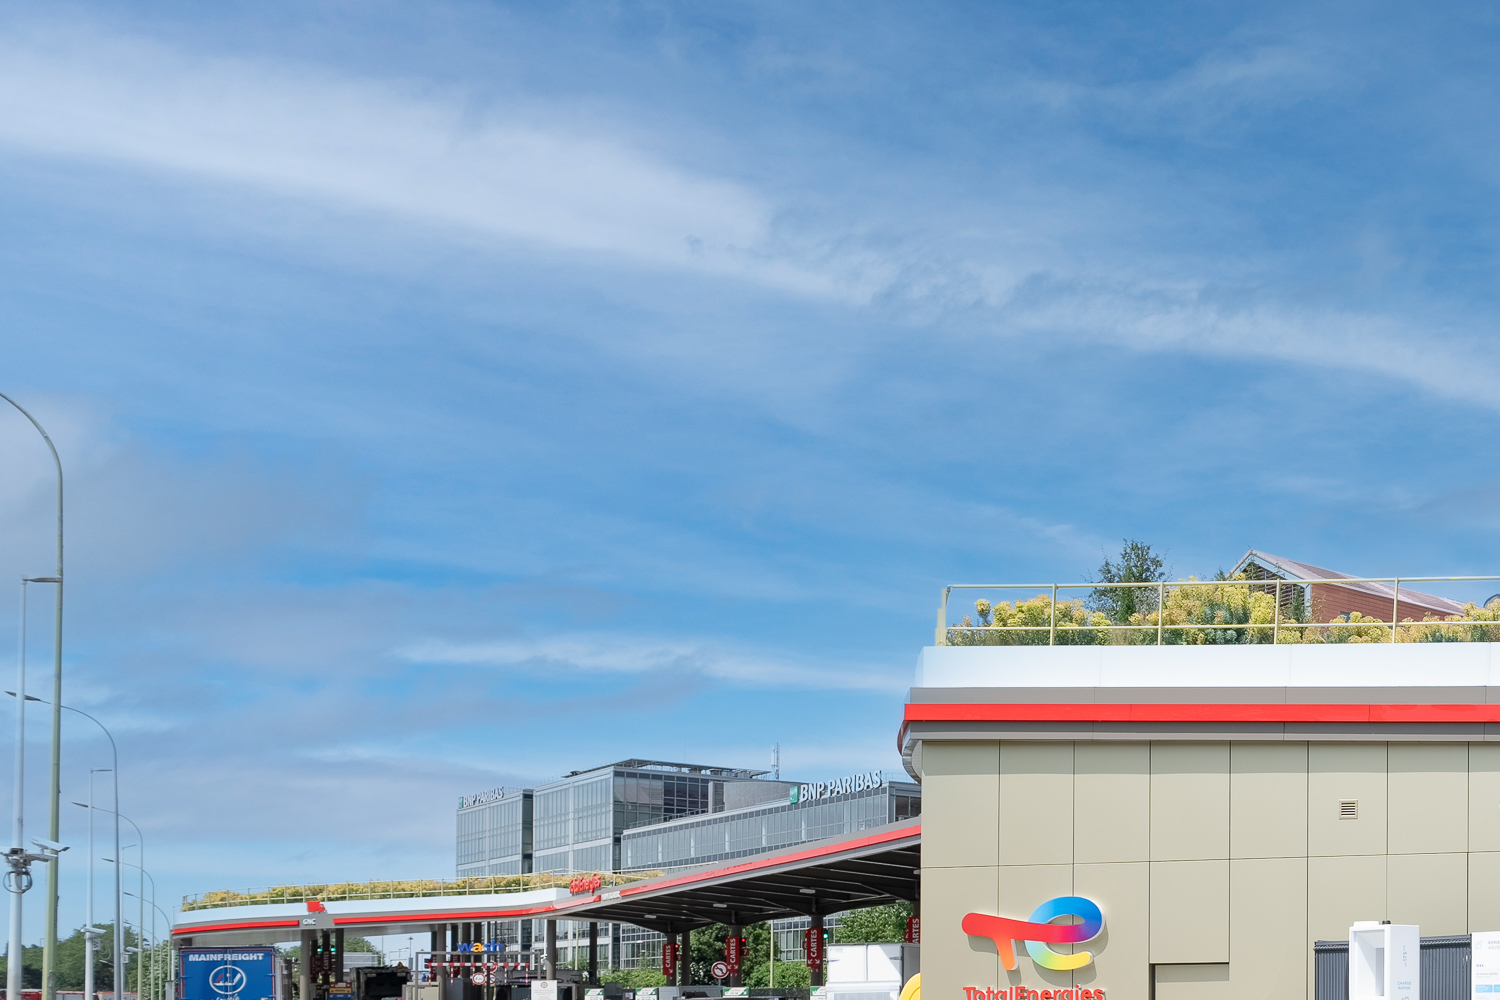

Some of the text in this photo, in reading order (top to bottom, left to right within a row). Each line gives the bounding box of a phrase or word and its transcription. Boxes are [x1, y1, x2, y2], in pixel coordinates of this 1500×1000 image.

[800, 770, 882, 801] BNP PARIBAS
[463, 787, 504, 807] BNP PARIBAS
[457, 940, 502, 953] wash
[188, 953, 264, 962] MAINFREIGHT
